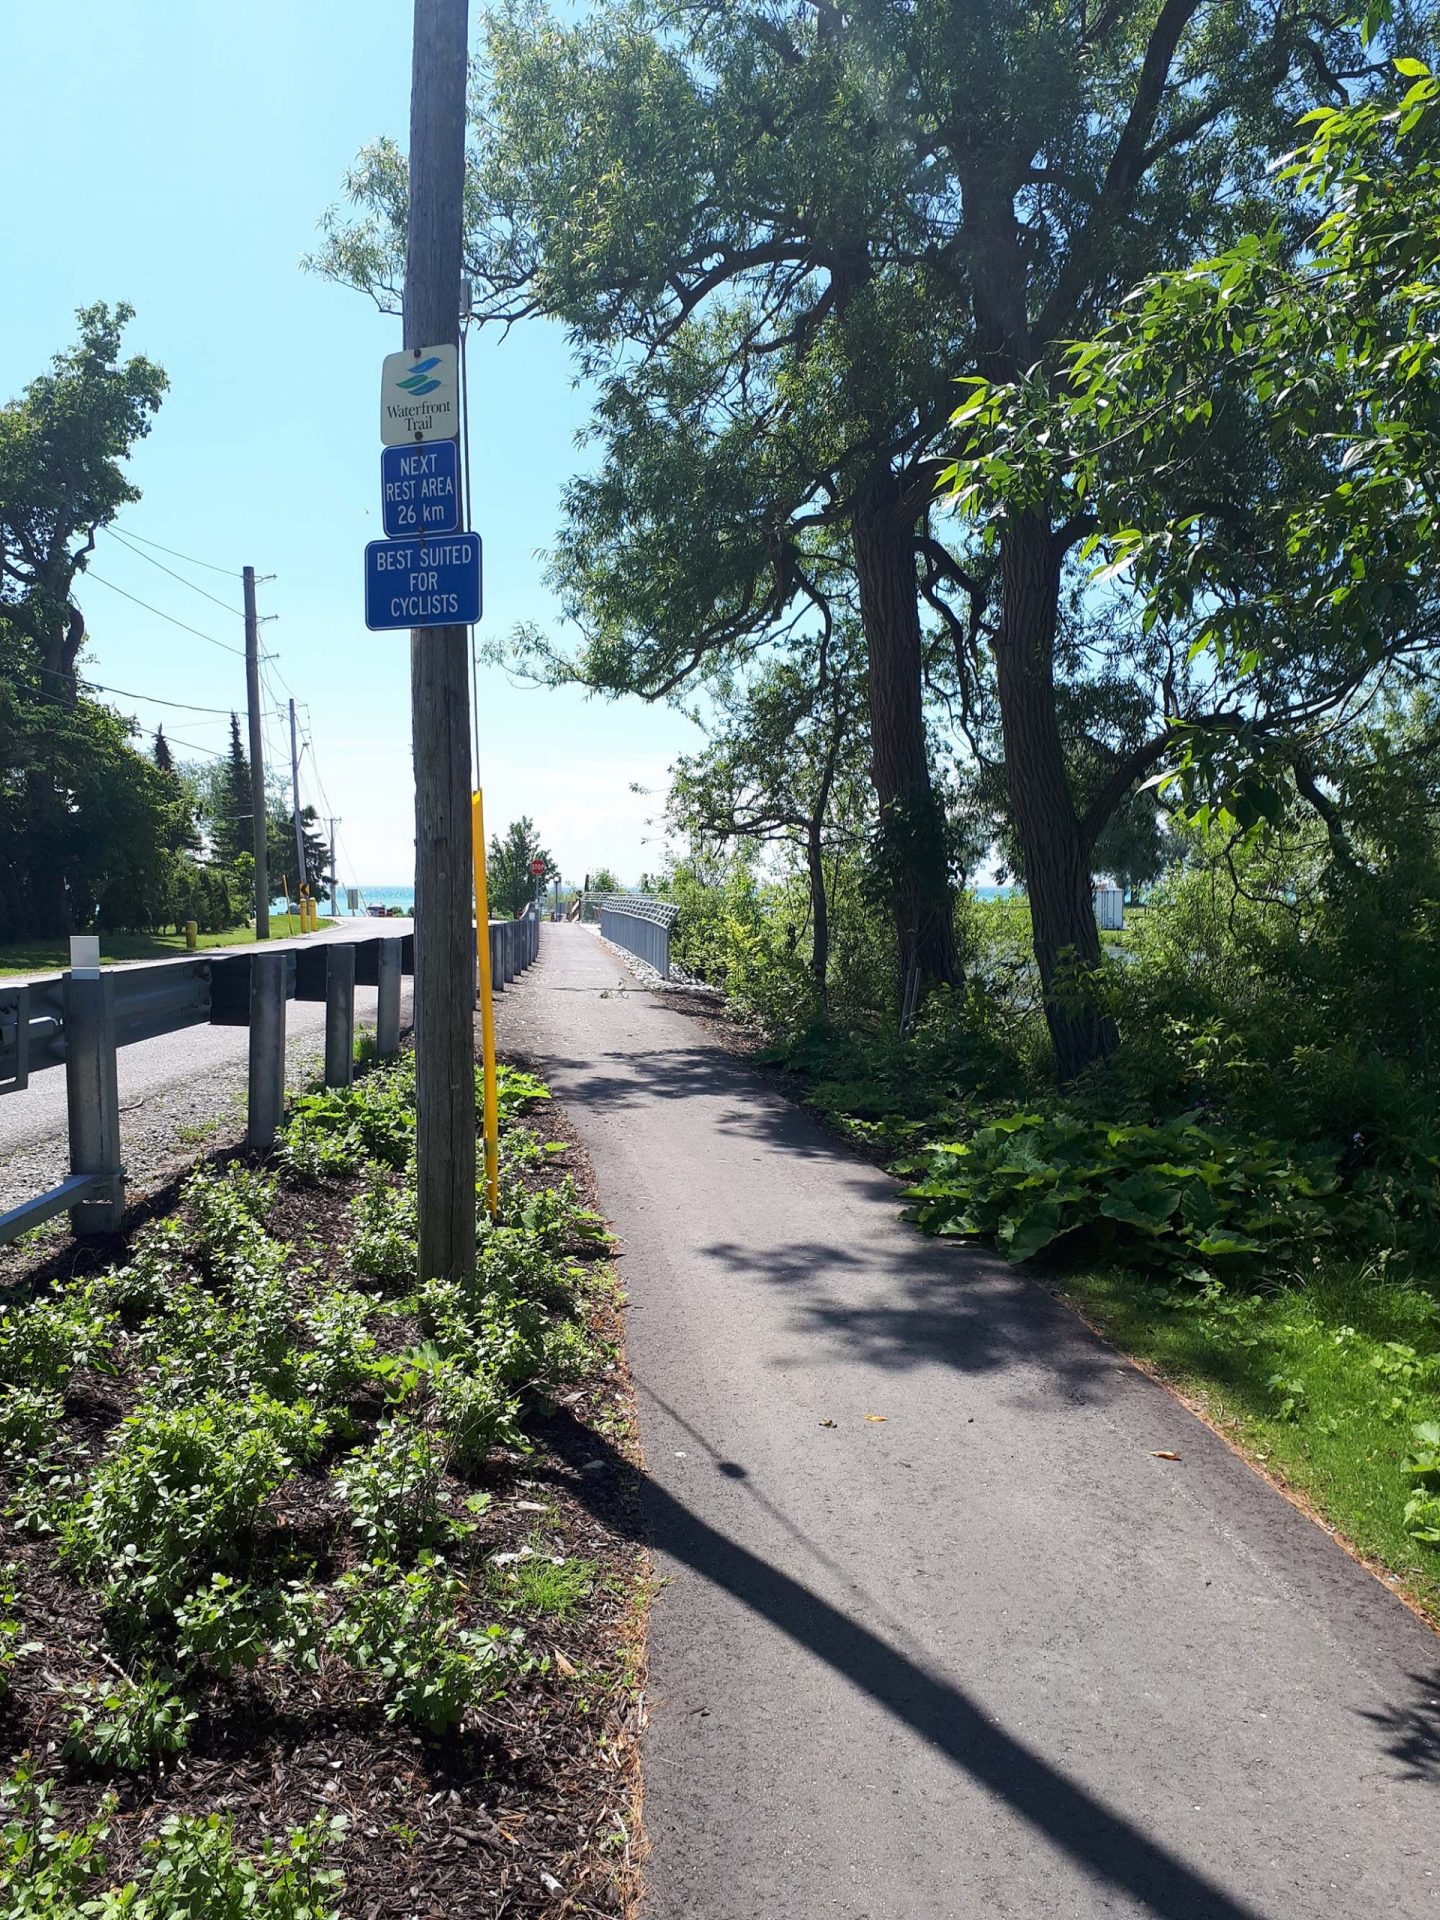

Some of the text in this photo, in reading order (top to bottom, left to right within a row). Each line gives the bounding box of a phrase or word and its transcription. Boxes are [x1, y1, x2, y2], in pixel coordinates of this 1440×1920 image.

[387, 400, 450, 418] Waterfront
[405, 414, 432, 431] Trail
[400, 454, 437, 476] NEXT
[386, 476, 454, 501] REST AREA
[398, 504, 445, 525] 26 km
[377, 545, 472, 571] BEST SUITED
[410, 572, 438, 591] FOR
[391, 594, 458, 617] CYCLISTS
[531, 863, 545, 871] STOP
